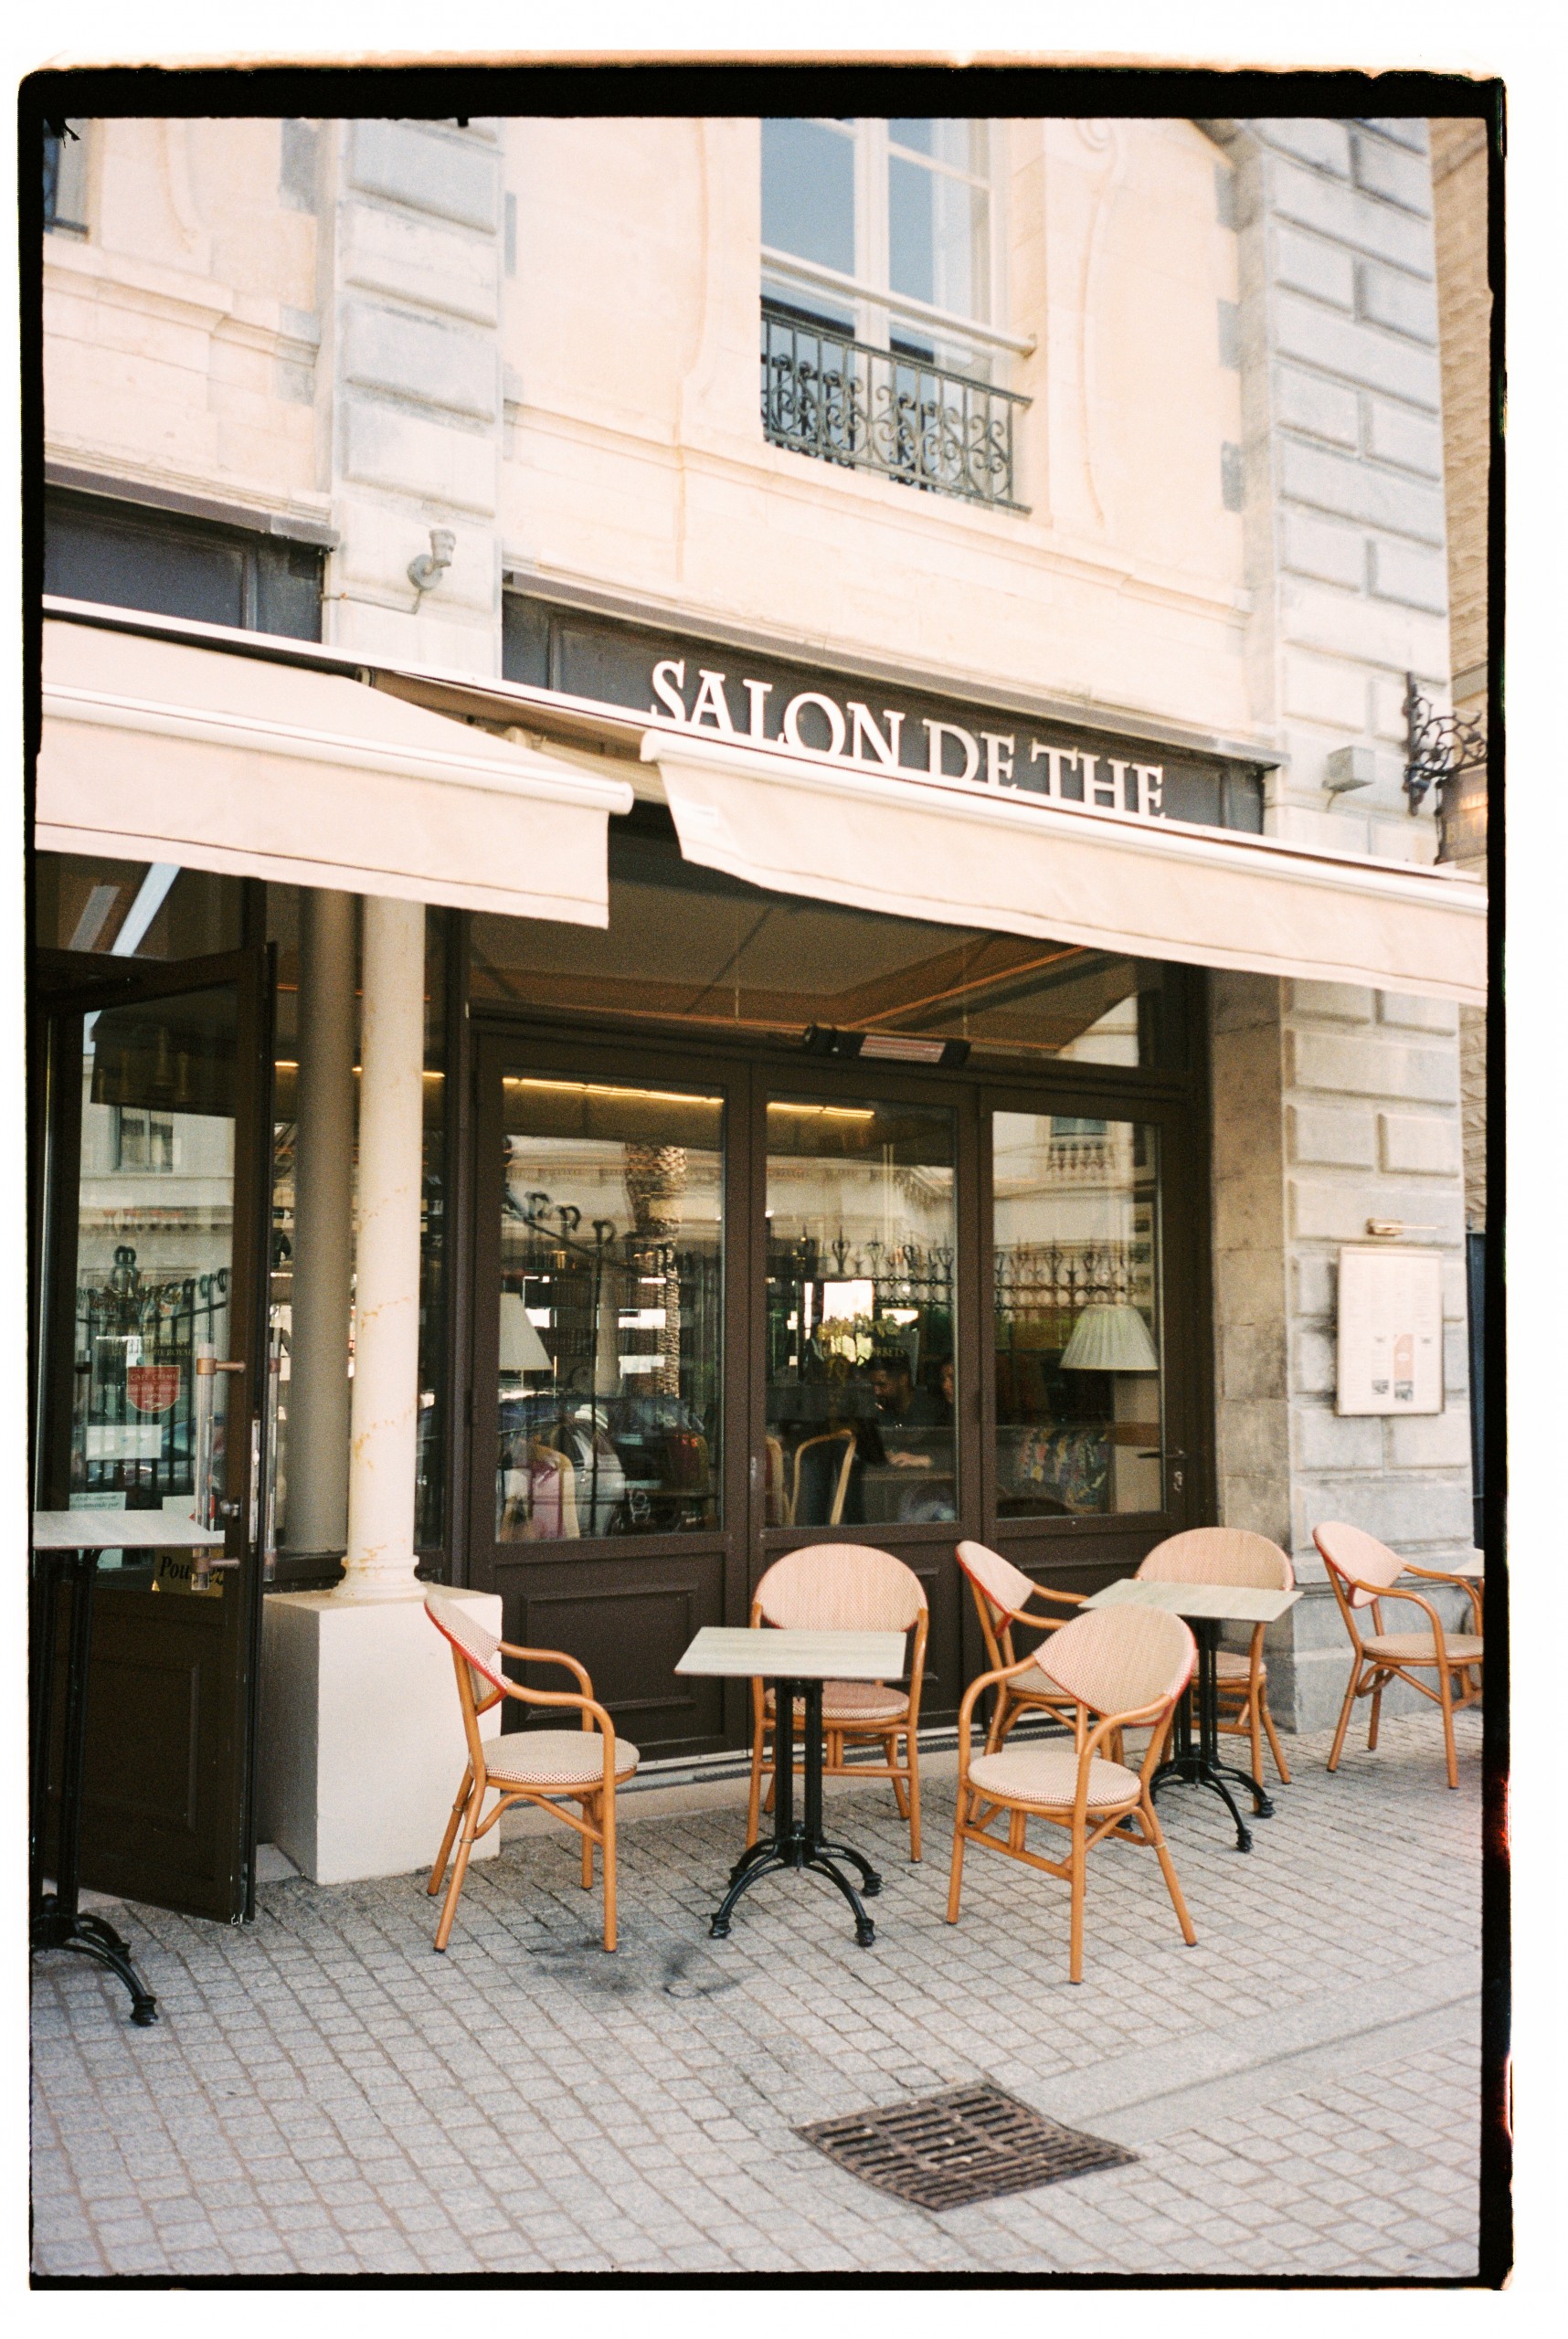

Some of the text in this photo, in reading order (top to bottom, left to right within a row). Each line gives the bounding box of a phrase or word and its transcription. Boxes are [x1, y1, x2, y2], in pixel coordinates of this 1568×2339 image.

[651, 660, 1166, 820] SALON DE THE
[158, 1555, 225, 1586] Pouez
